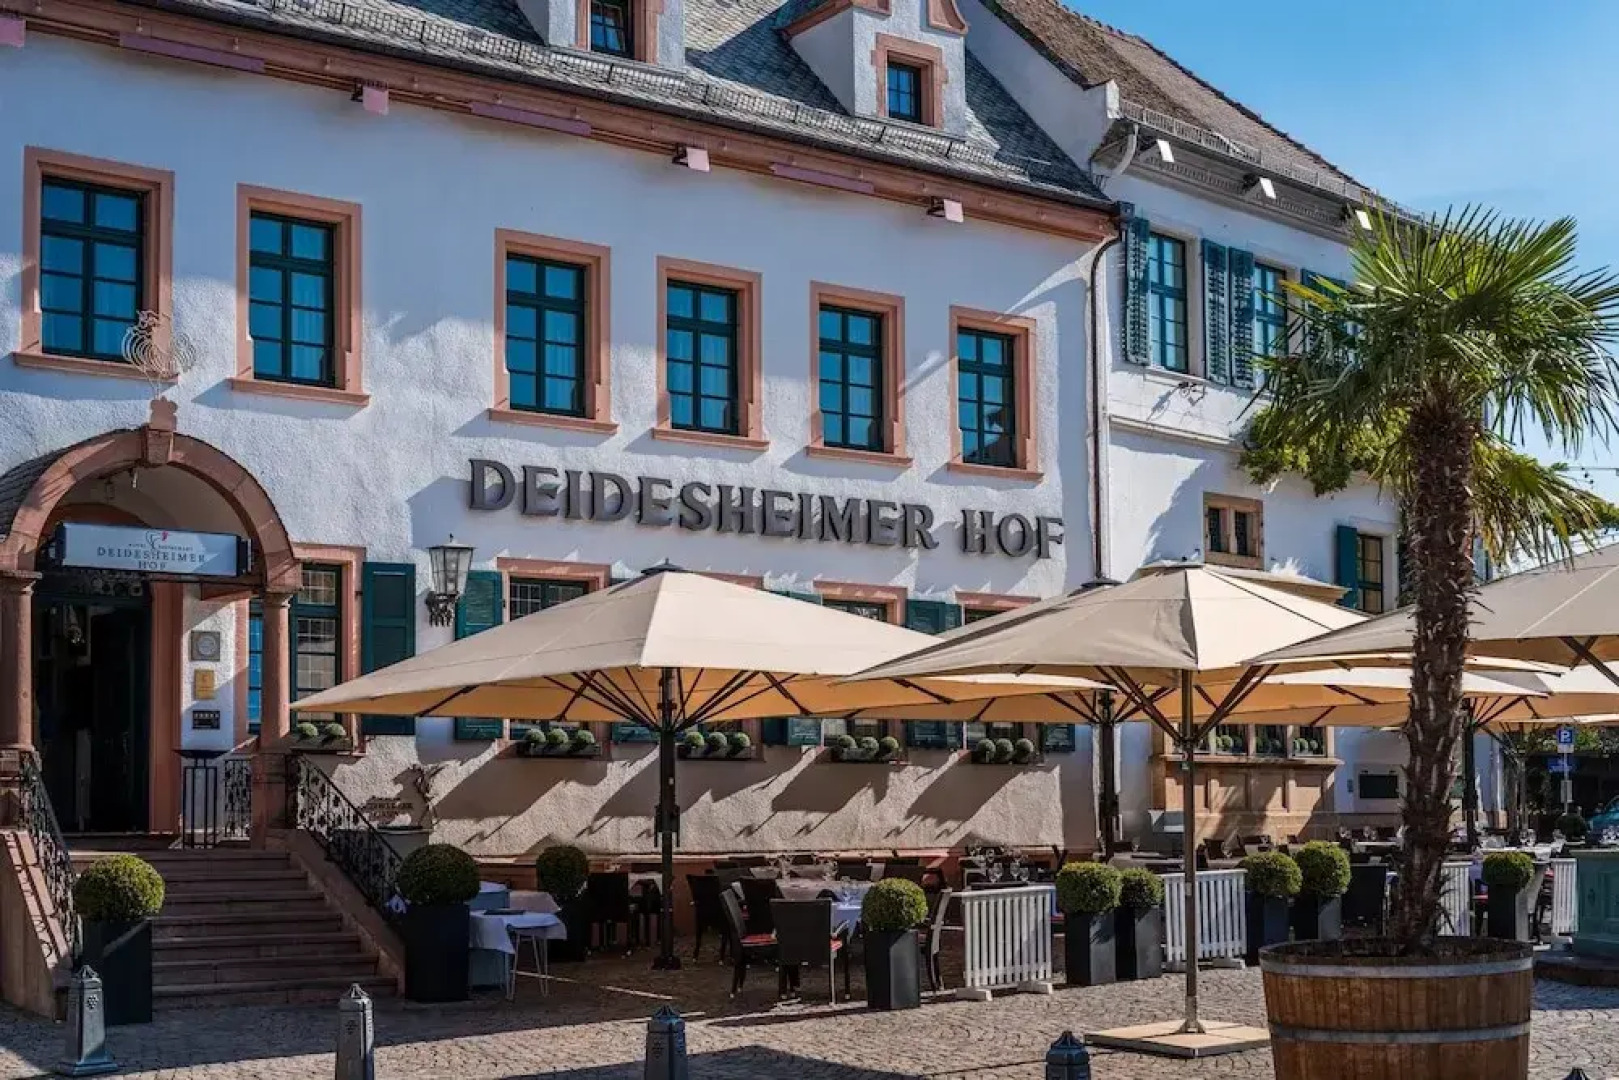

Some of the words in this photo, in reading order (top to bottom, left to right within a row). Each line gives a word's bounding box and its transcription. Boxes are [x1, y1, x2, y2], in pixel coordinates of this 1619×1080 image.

[468, 457, 940, 550] DEIDESHEIMER
[961, 508, 1064, 560] HOF
[97, 546, 206, 563] DEIDESHEIMER
[138, 560, 168, 570] HOF
[1560, 731, 1571, 743] P
